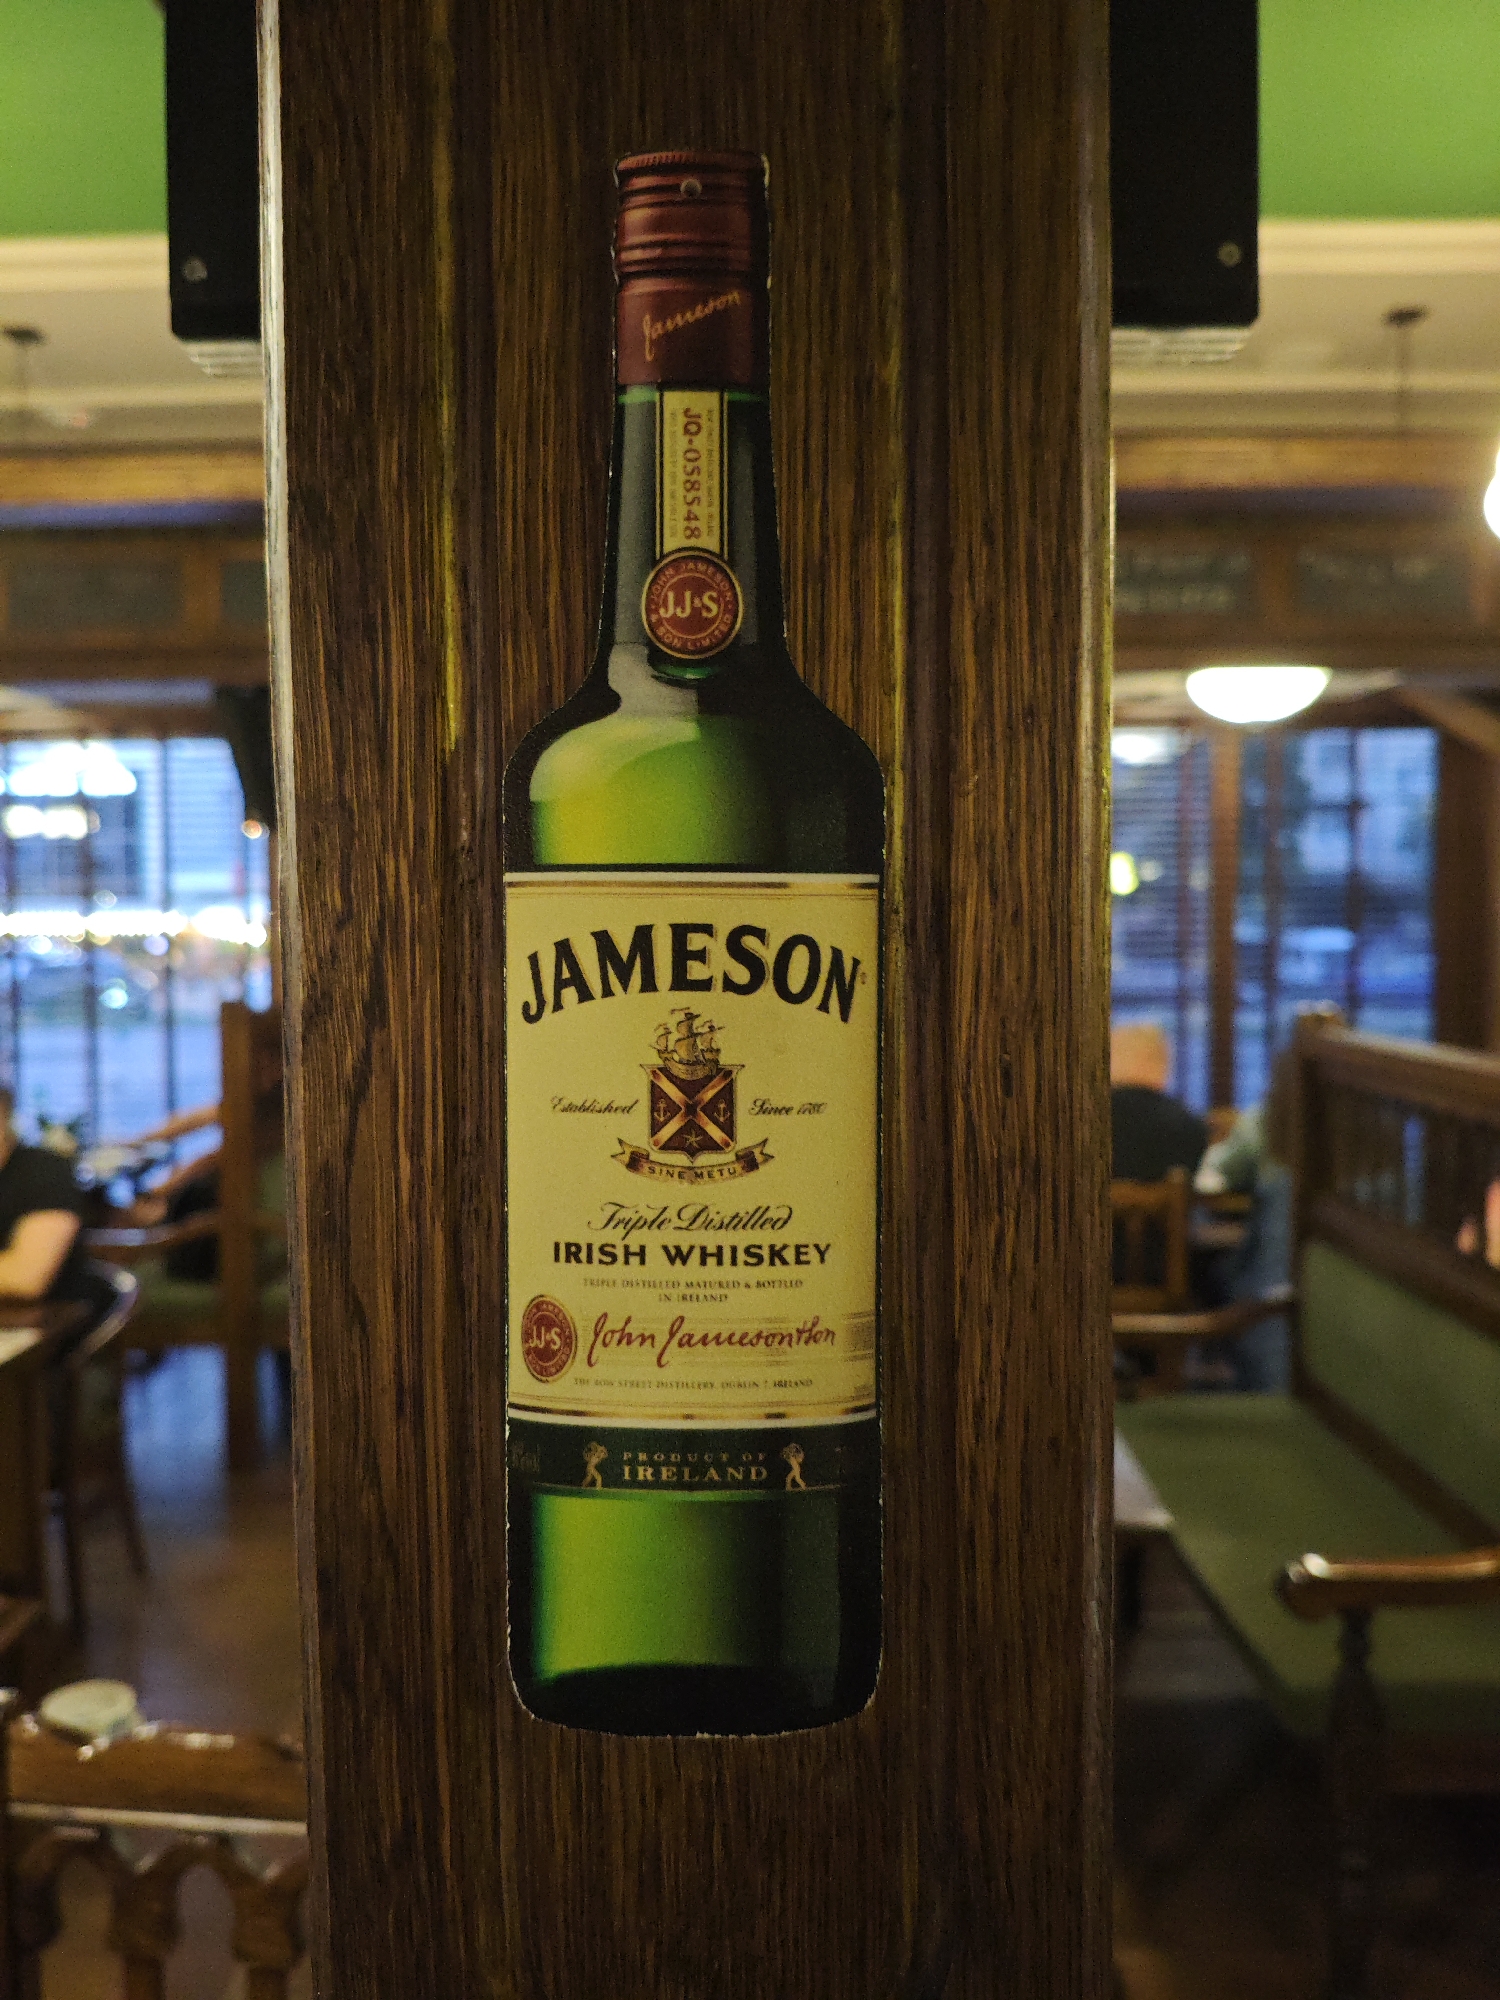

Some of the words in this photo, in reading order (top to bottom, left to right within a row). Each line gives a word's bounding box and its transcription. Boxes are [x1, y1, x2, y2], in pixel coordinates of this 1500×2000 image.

[642, 289, 741, 362] Jameson
[521, 922, 861, 1025] JAMESON
[748, 1098, 794, 1116] Since
[647, 1165, 687, 1180] SINE
[693, 1166, 737, 1180] METU
[587, 1201, 671, 1241] Triple
[672, 1203, 793, 1232] Distilled
[553, 1241, 646, 1266] IRISH
[661, 1243, 831, 1267] WHISKEY
[587, 1311, 656, 1368] John
[623, 1451, 729, 1463] PRODUCT
[742, 1451, 766, 1463] OF
[623, 1463, 769, 1482] IRELAND
